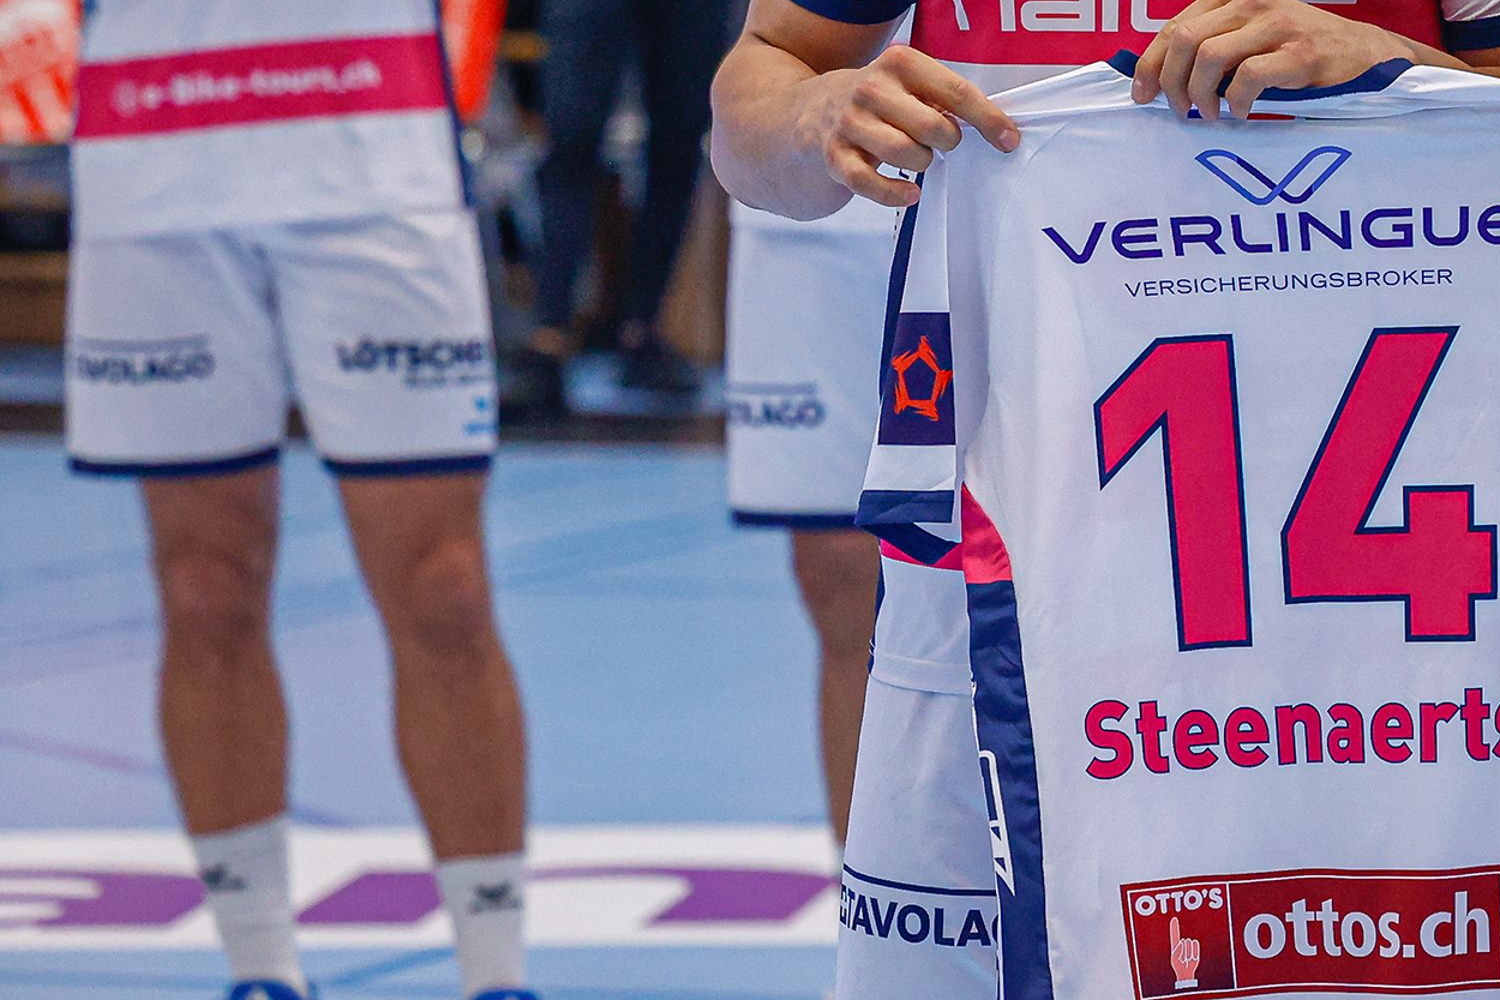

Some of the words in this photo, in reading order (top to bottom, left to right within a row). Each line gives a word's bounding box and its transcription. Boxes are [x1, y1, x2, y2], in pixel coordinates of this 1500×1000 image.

[1124, 268, 1453, 298] VERSICHERUNGSBROKER
[1094, 326, 1498, 652] 14
[1134, 887, 1224, 917] OTTO'S
[1242, 890, 1492, 959] ottos.ch
